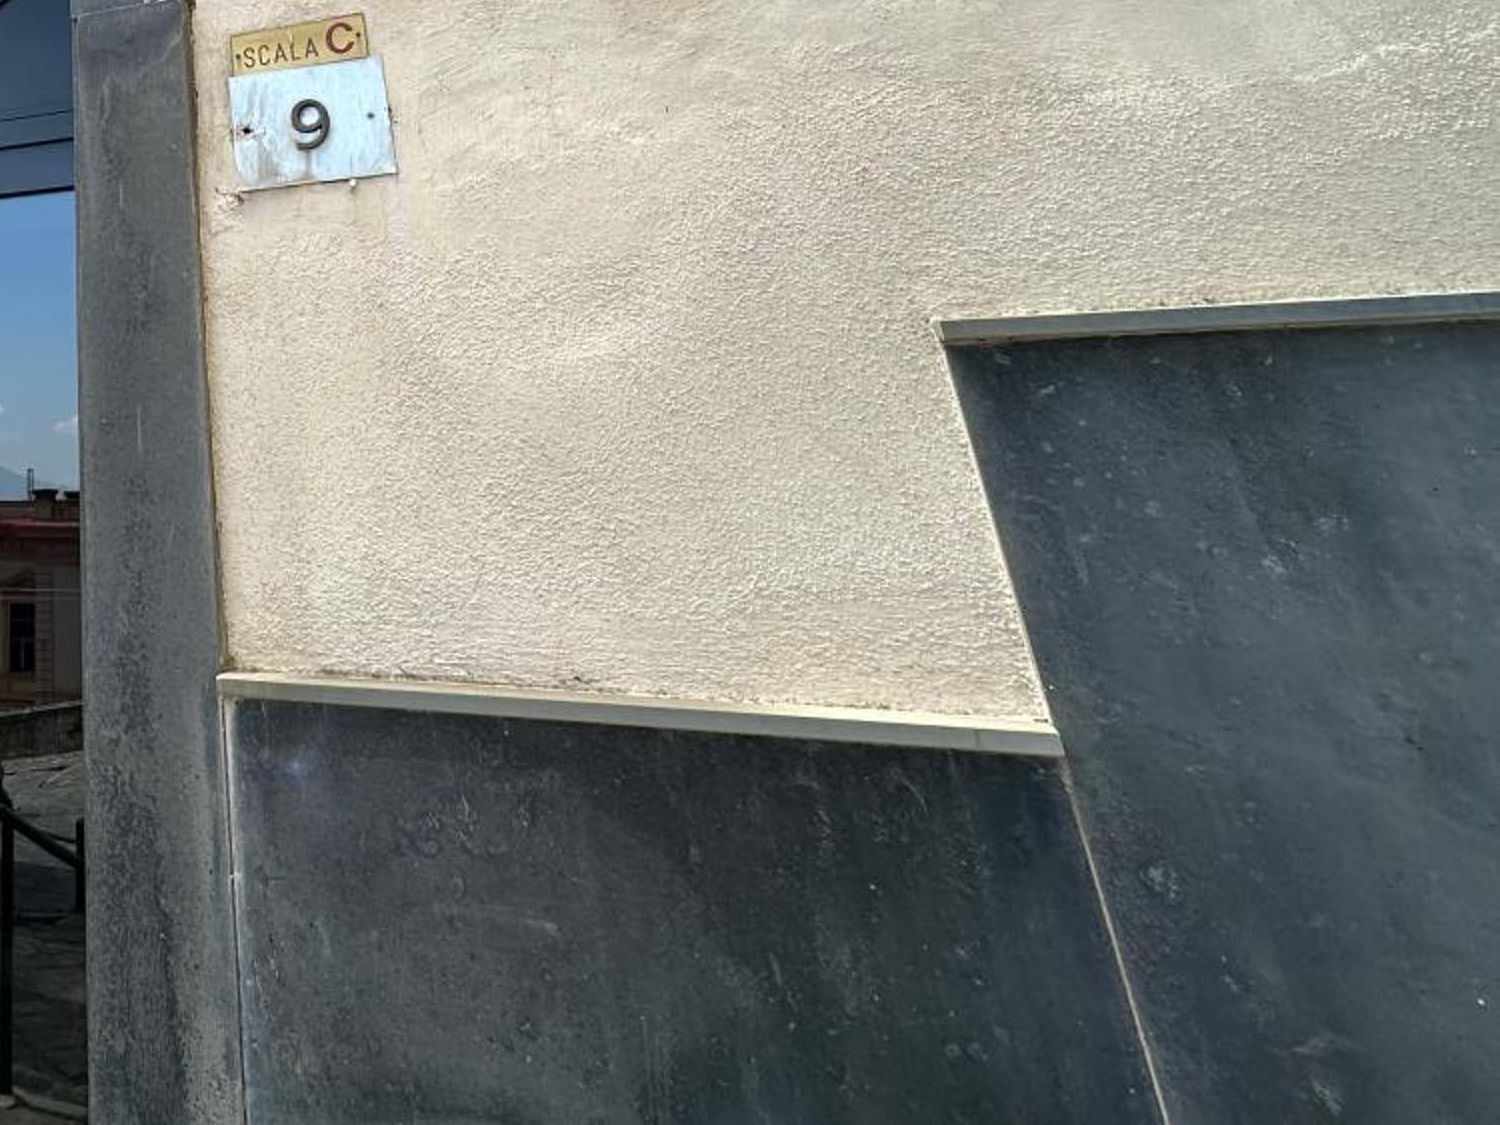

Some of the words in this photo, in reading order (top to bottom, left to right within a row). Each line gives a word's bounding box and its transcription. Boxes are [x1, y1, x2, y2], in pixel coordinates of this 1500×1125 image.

[243, 38, 319, 68] SCALA
[325, 22, 355, 54] C
[292, 98, 330, 150] 9
